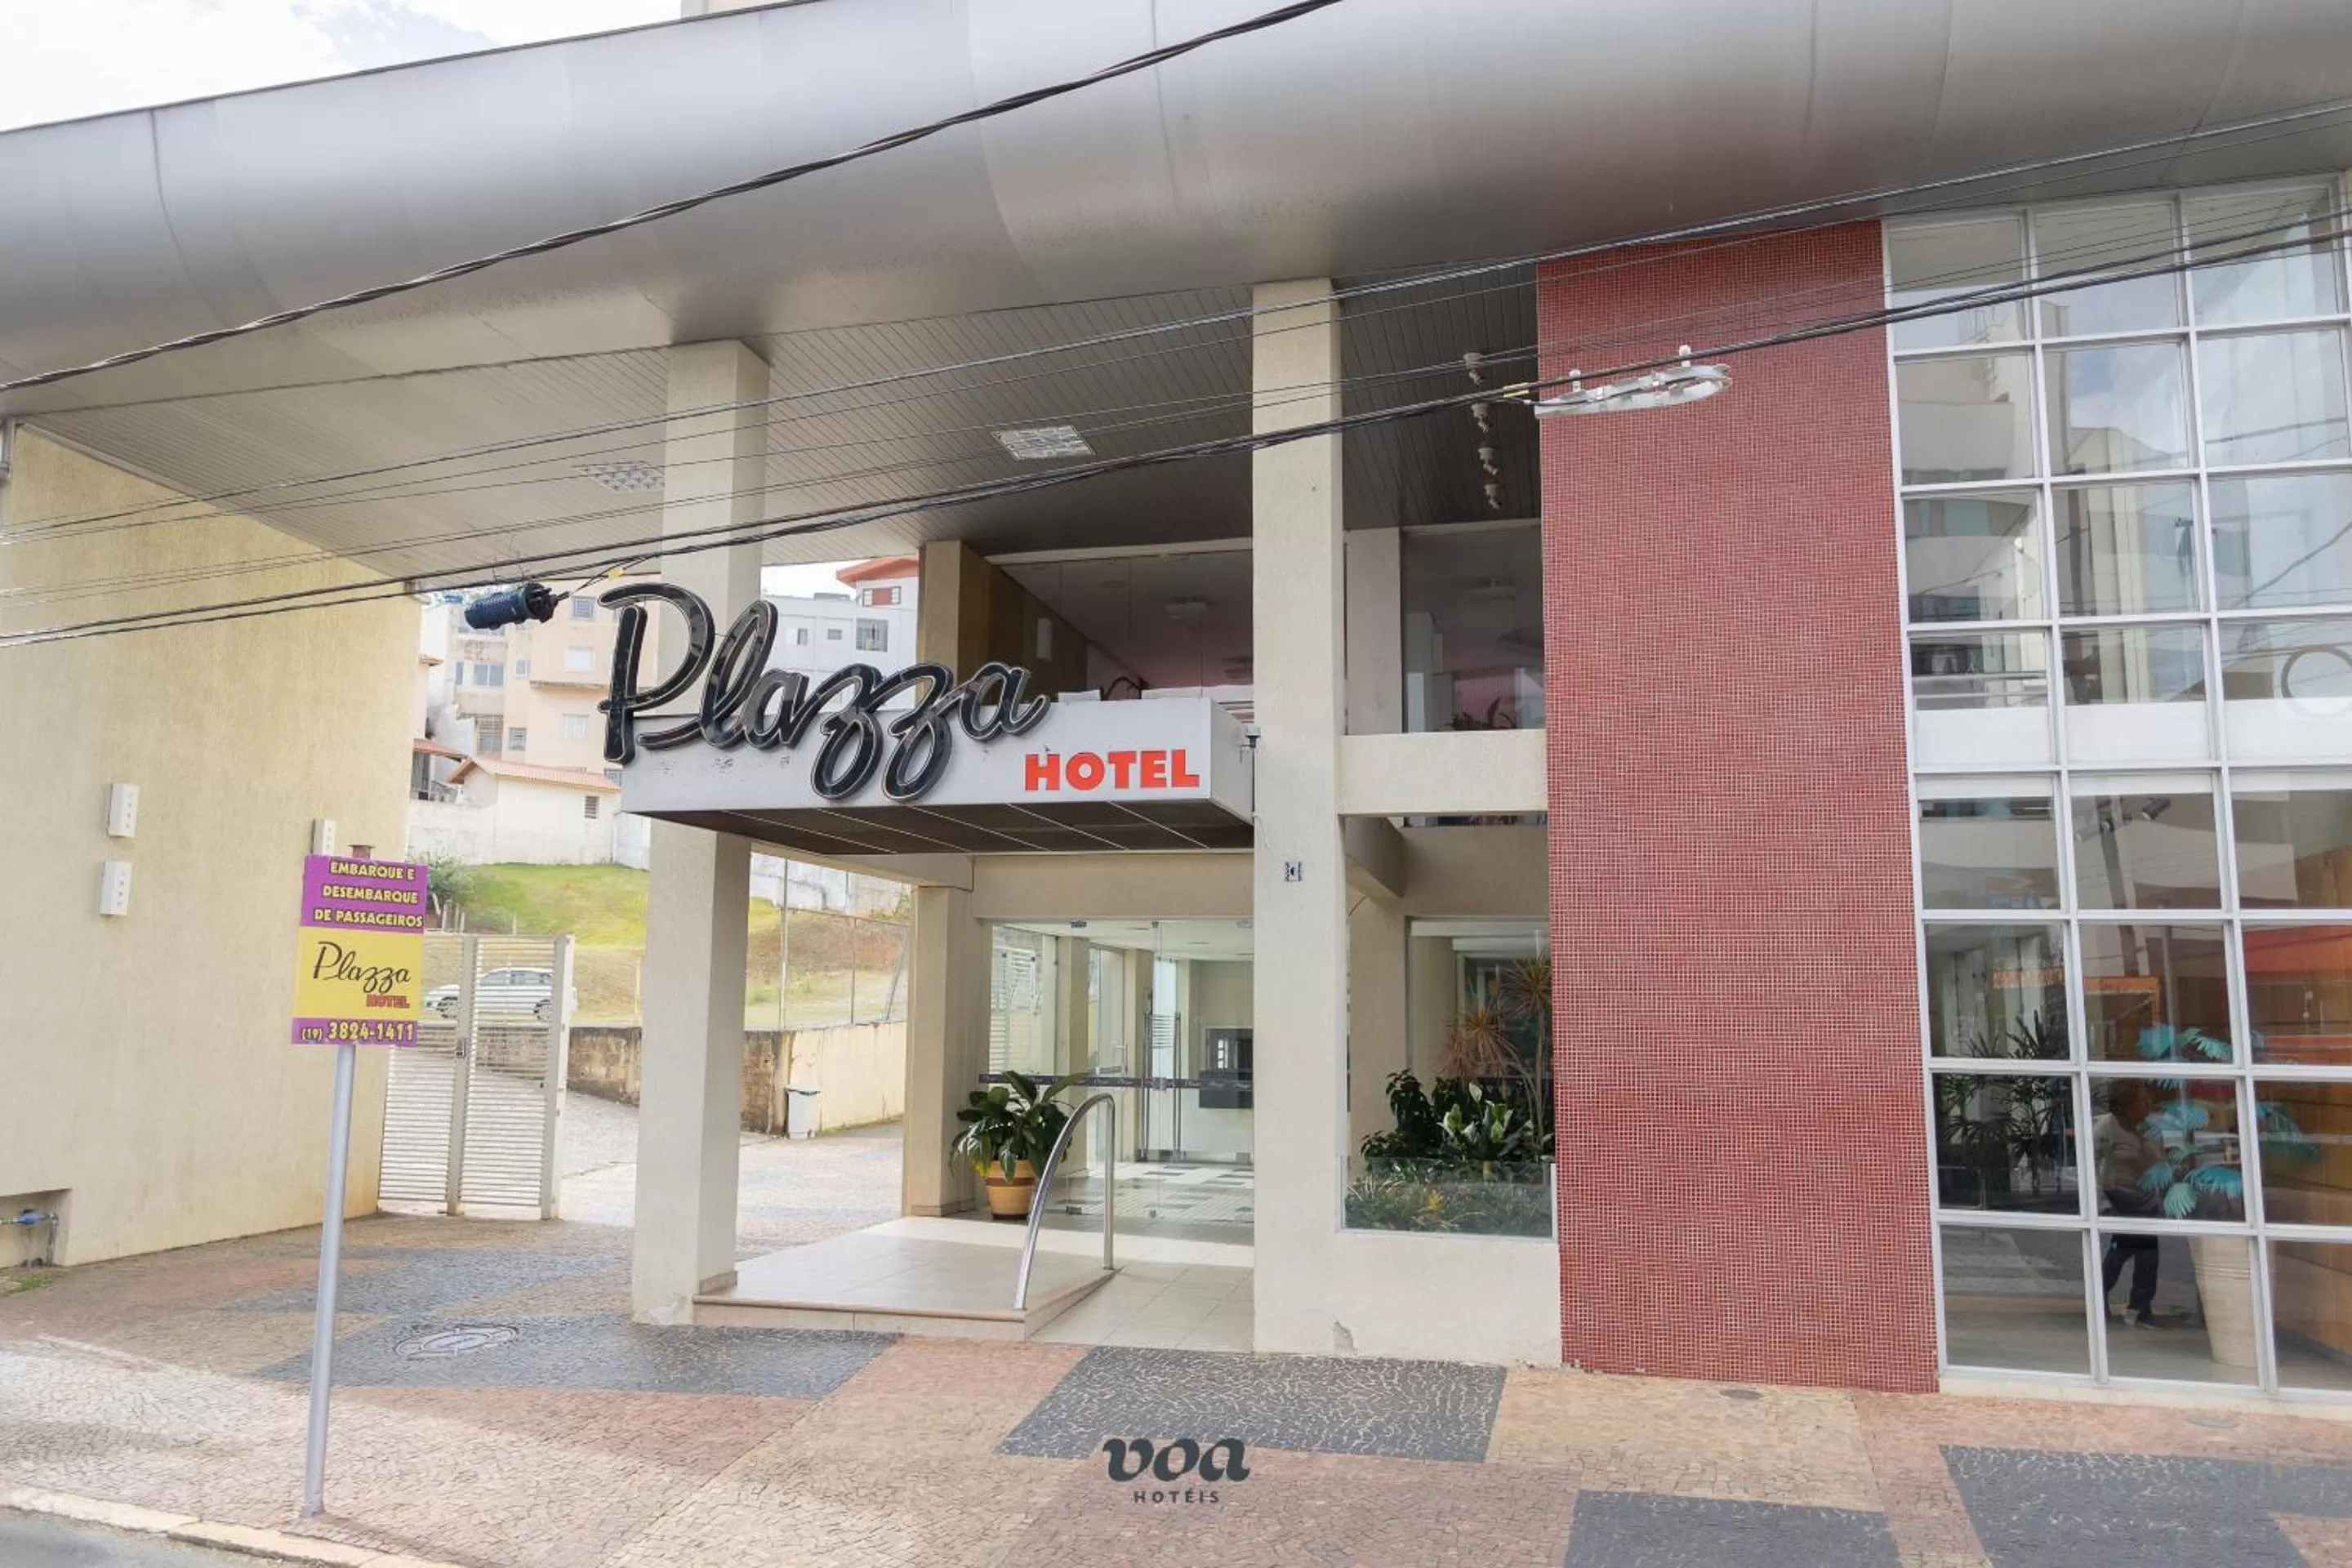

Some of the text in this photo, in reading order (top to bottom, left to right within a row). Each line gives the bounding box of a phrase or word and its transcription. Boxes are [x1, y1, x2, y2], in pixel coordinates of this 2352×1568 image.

[596, 582, 1050, 801] Plazza
[1024, 749, 1200, 791] HOTEL
[330, 862, 416, 880] EMBARQUE E
[323, 884, 418, 904] DESEMBARQUE
[314, 908, 423, 928] DE PASSAGEIROS
[313, 941, 411, 994] Plazza
[366, 994, 410, 1009] HOTEL
[301, 1021, 414, 1041] (19) 3824-1411
